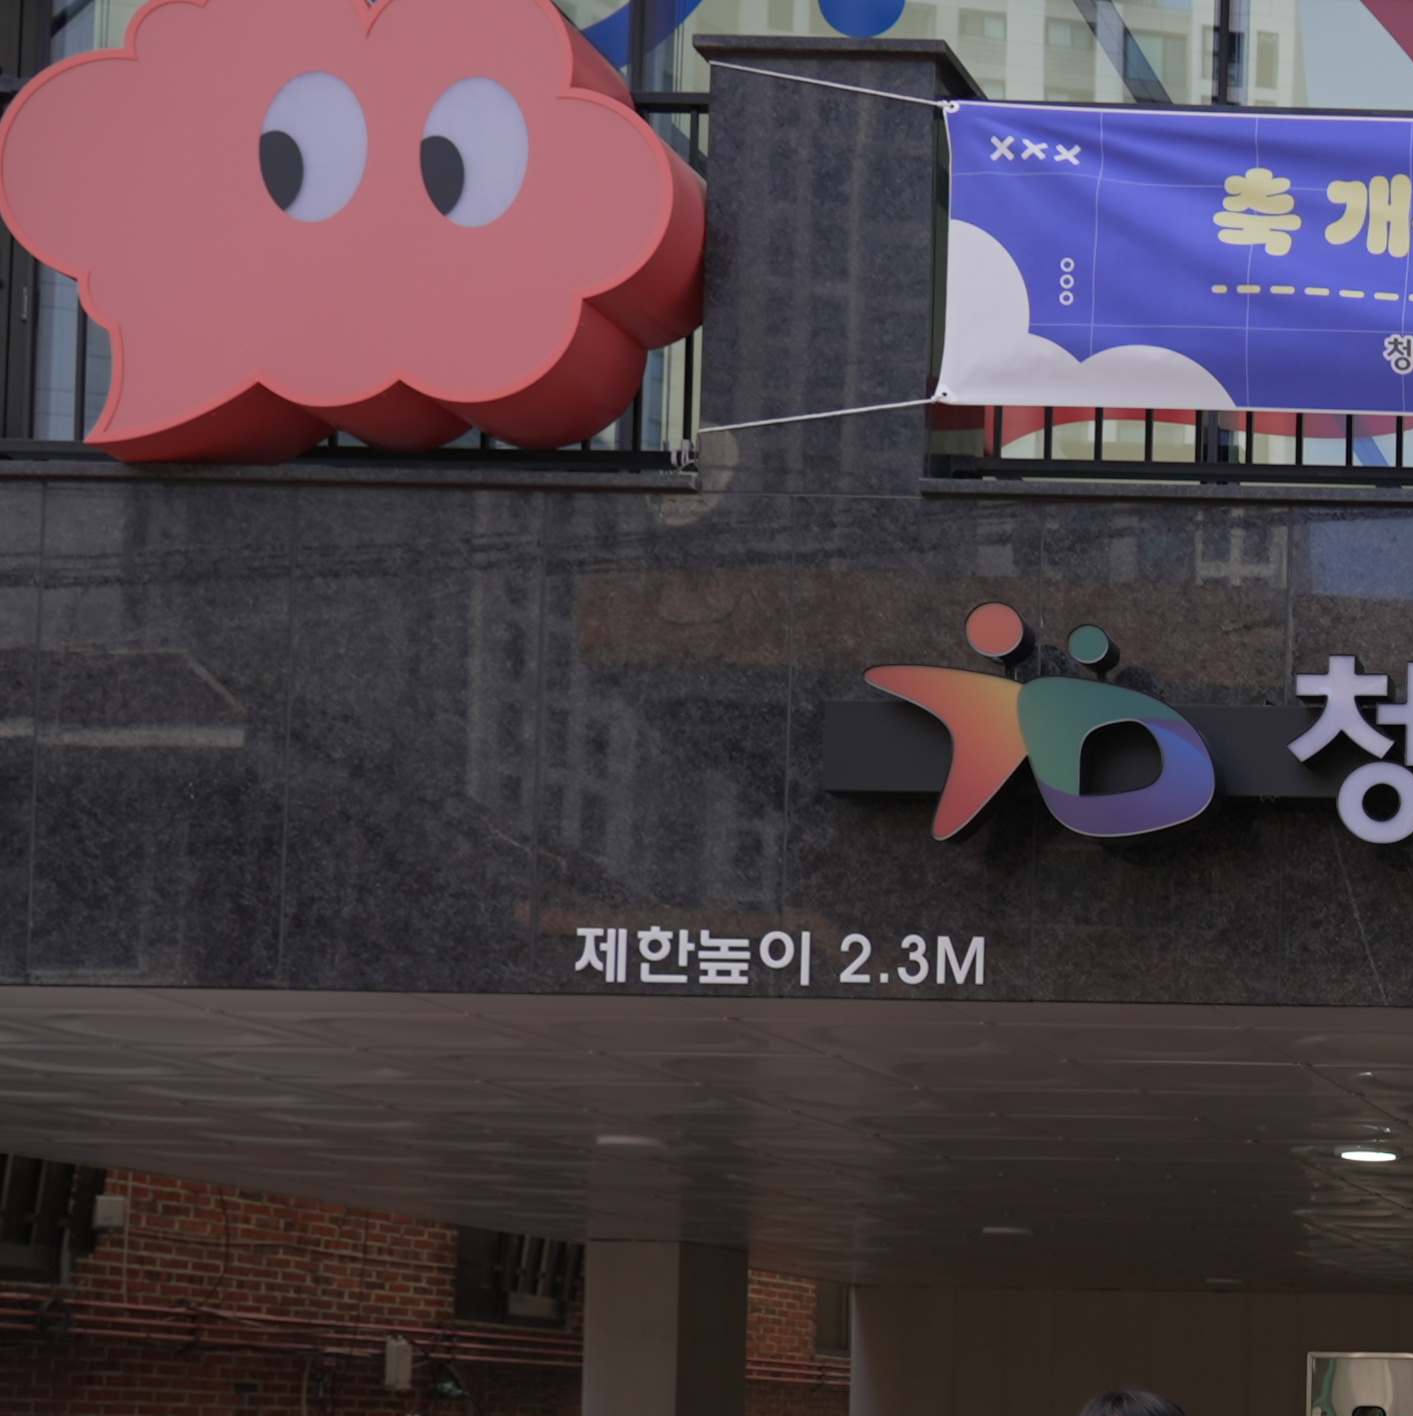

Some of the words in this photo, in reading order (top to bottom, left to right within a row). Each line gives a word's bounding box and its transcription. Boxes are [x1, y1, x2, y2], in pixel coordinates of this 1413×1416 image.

[1212, 167, 1302, 257] 축
[574, 925, 813, 988] 제한높이
[838, 934, 985, 988] 2.3M
